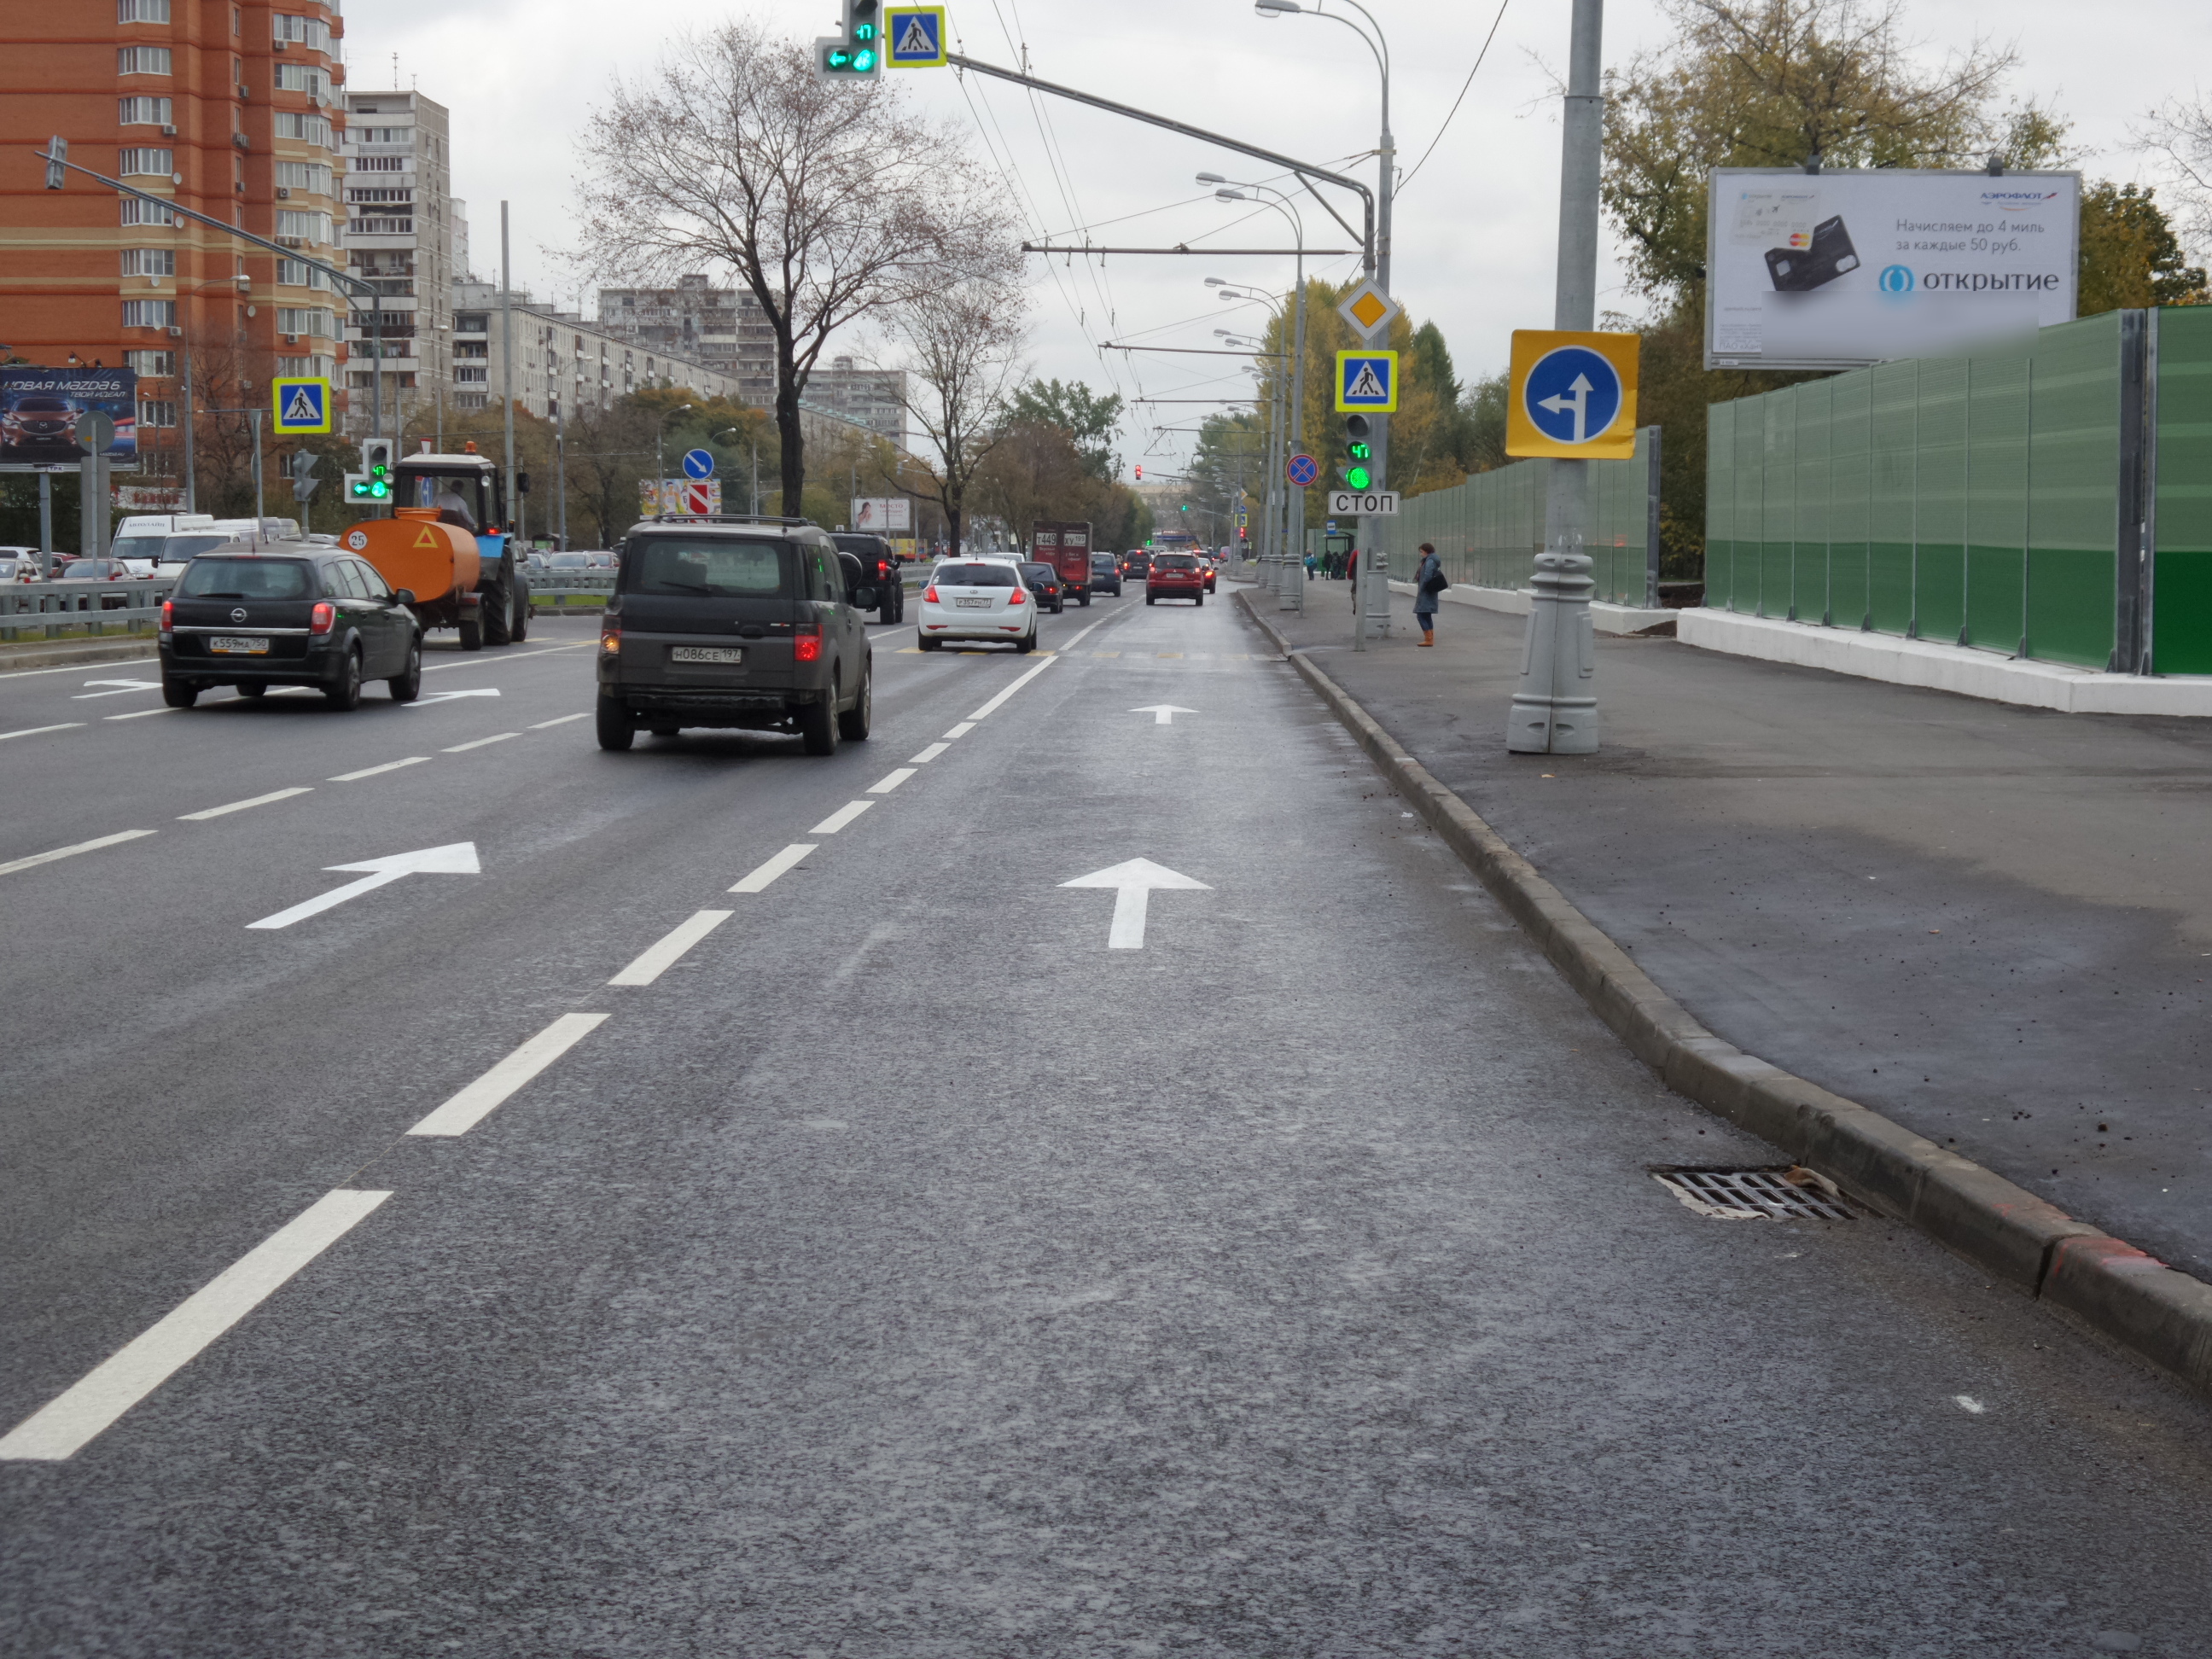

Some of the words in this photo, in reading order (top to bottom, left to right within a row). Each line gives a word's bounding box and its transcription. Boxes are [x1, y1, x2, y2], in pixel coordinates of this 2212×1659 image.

[1896, 219, 1973, 232] Начисляем
[1976, 224, 1994, 234] до
[1998, 219, 2006, 232] 4
[2011, 224, 2045, 233] миль
[1896, 242, 1910, 250] за
[1914, 242, 1966, 251] каждые
[1970, 238, 1988, 251] 50
[1992, 238, 2022, 254] руб.
[1924, 273, 2060, 291] открытие
[3, 381, 55, 391] НОВАЯ
[372, 466, 384, 475] 47
[1336, 494, 1393, 512] СТОП
[351, 535, 364, 546] 25
